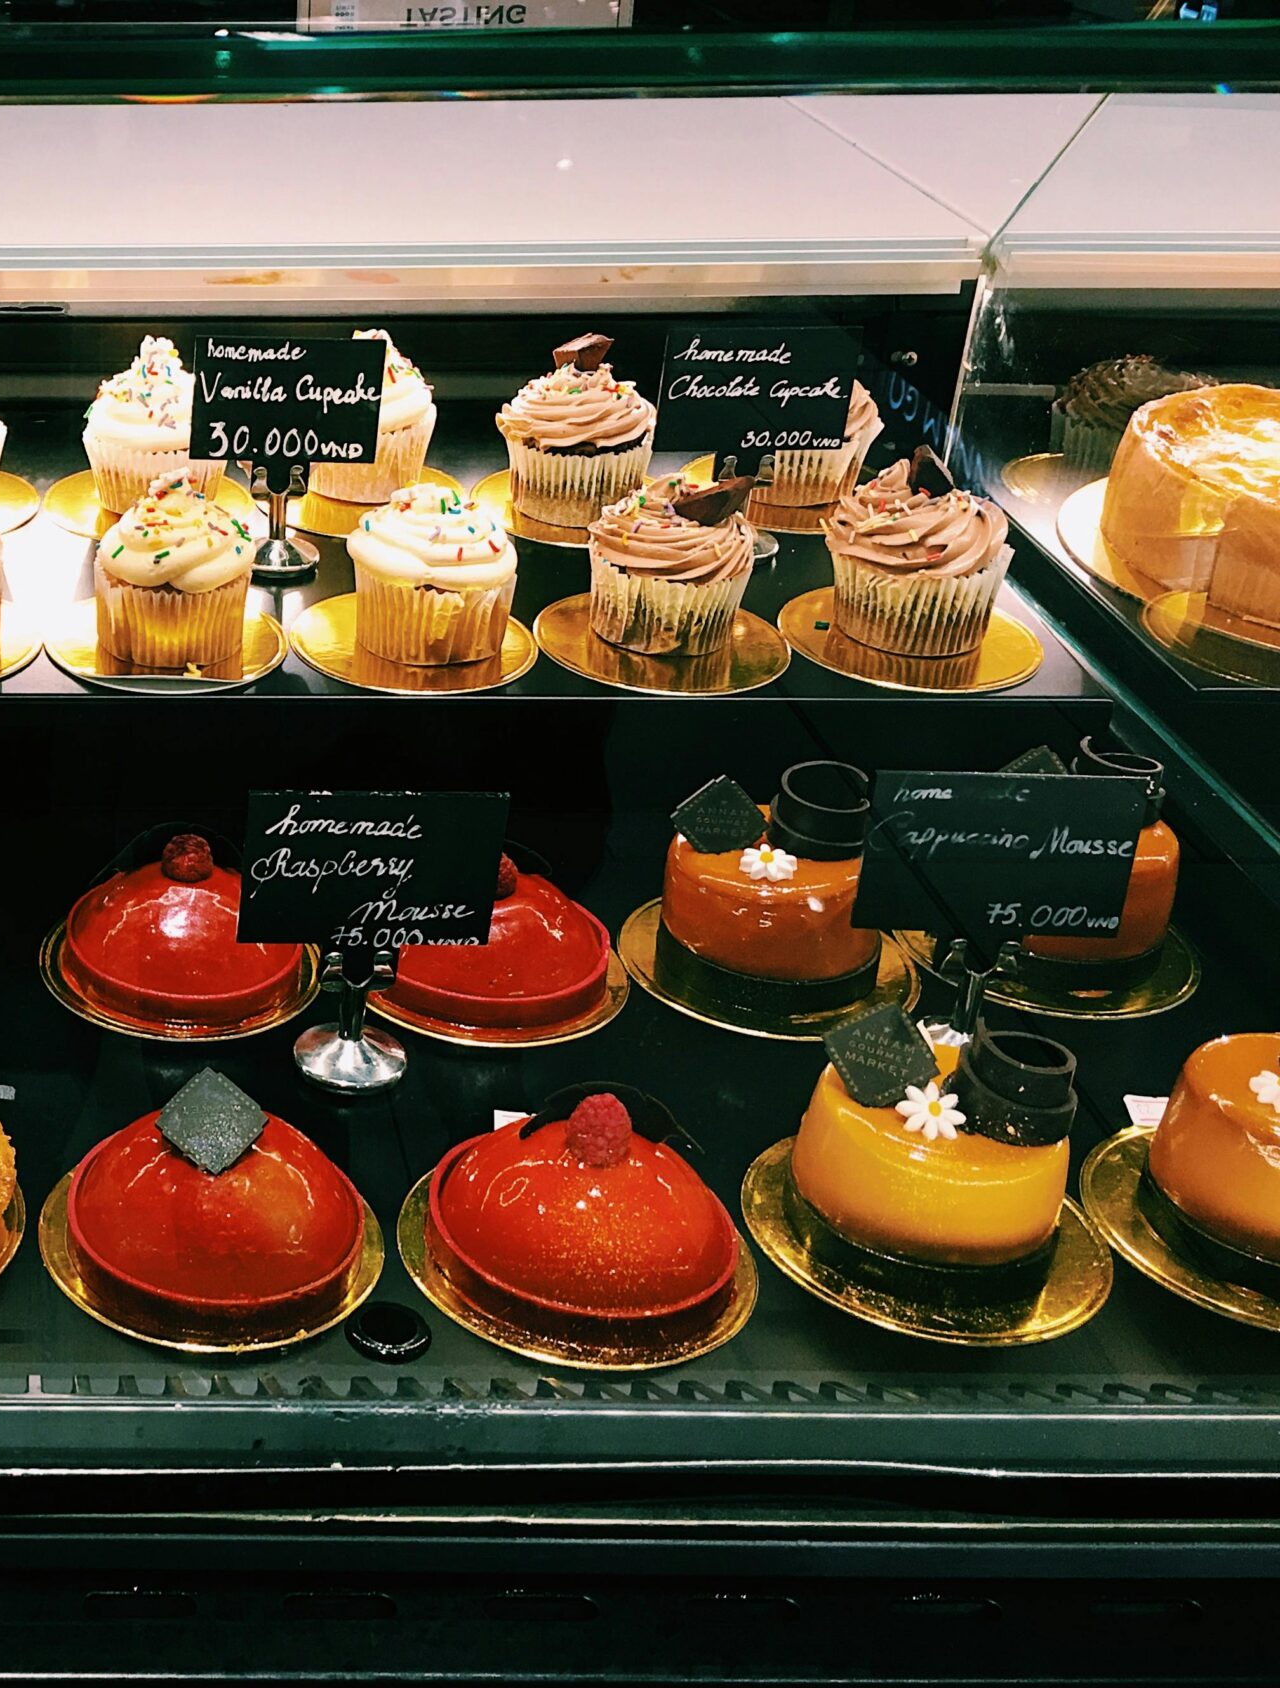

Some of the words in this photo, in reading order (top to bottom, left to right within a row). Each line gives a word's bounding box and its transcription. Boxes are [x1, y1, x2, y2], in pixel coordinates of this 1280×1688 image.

[208, 338, 306, 362] homemade
[674, 338, 791, 364] homemade
[200, 371, 287, 403] Vanilla
[295, 372, 381, 413] Cupcake
[668, 374, 760, 400] Chocolate
[265, 804, 422, 840] homemade
[1029, 826, 1134, 860] Mousse
[250, 847, 414, 899] Raspberry
[348, 899, 475, 924] Mousse
[852, 1028, 916, 1054] ANNAM
[844, 1051, 909, 1076] MARKET
